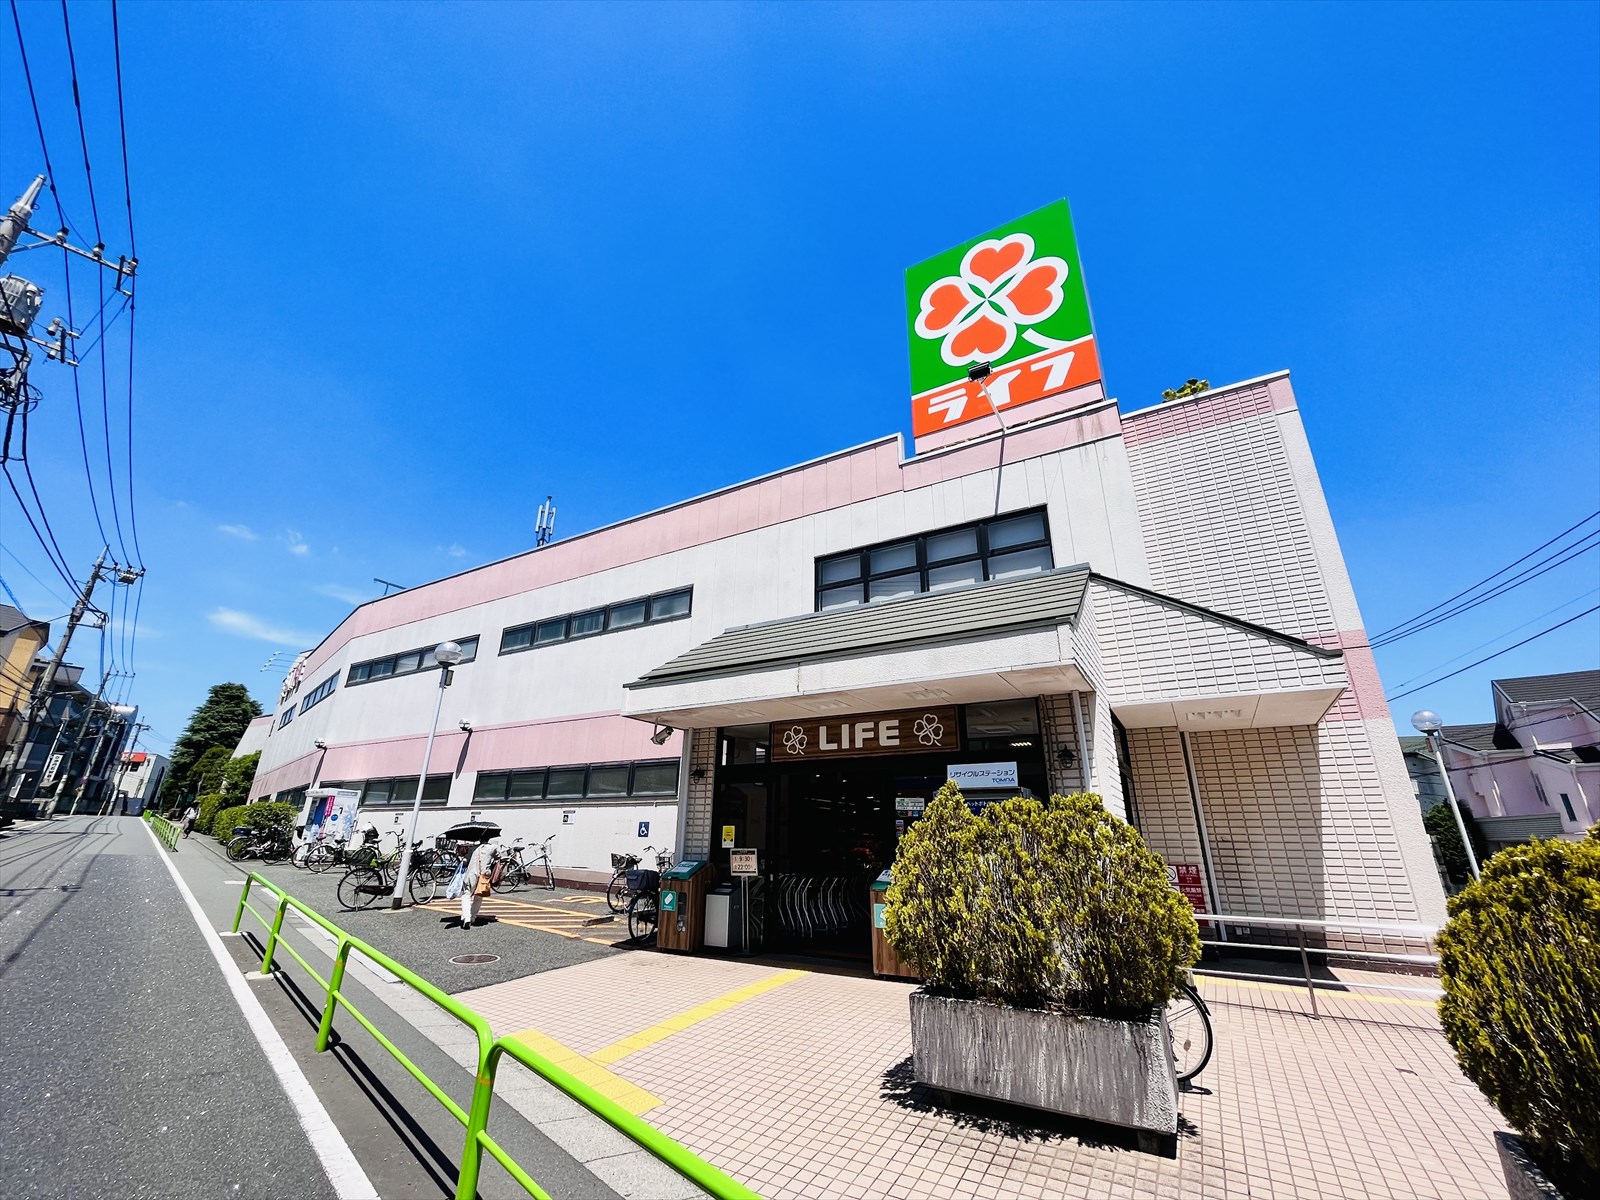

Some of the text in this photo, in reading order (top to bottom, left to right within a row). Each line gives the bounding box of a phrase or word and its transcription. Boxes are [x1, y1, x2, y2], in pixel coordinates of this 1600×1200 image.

[927, 351, 1075, 424] ライフ
[819, 719, 900, 750] LIFE
[949, 769, 1015, 778] リサイクルステーション
[1178, 866, 1198, 874] 禁煙
